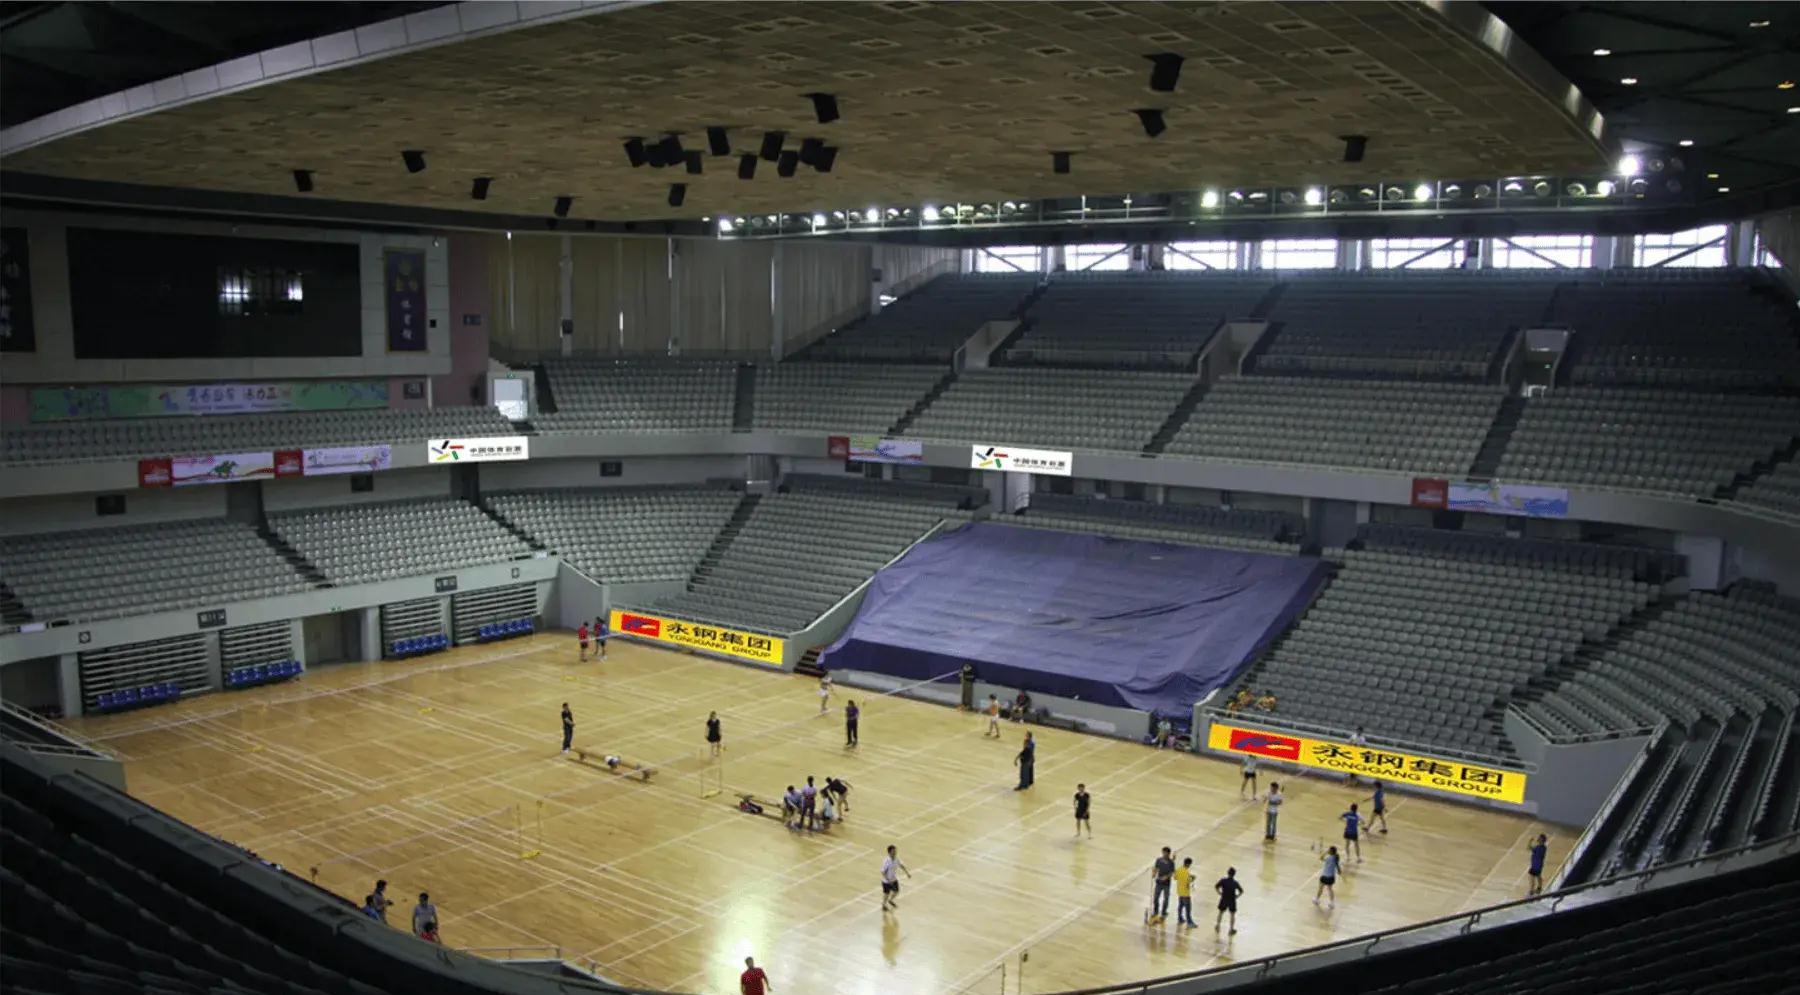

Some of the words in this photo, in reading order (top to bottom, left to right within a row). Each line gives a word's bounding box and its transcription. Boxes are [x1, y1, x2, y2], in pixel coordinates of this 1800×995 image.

[667, 622, 771, 651] 永钢集团
[669, 634, 727, 650] YONGGANG
[732, 646, 771, 657] GROUP
[1312, 743, 1503, 787] 永钢集团
[1316, 757, 1421, 781] YONGGANG
[1432, 777, 1503, 795] GROUP
